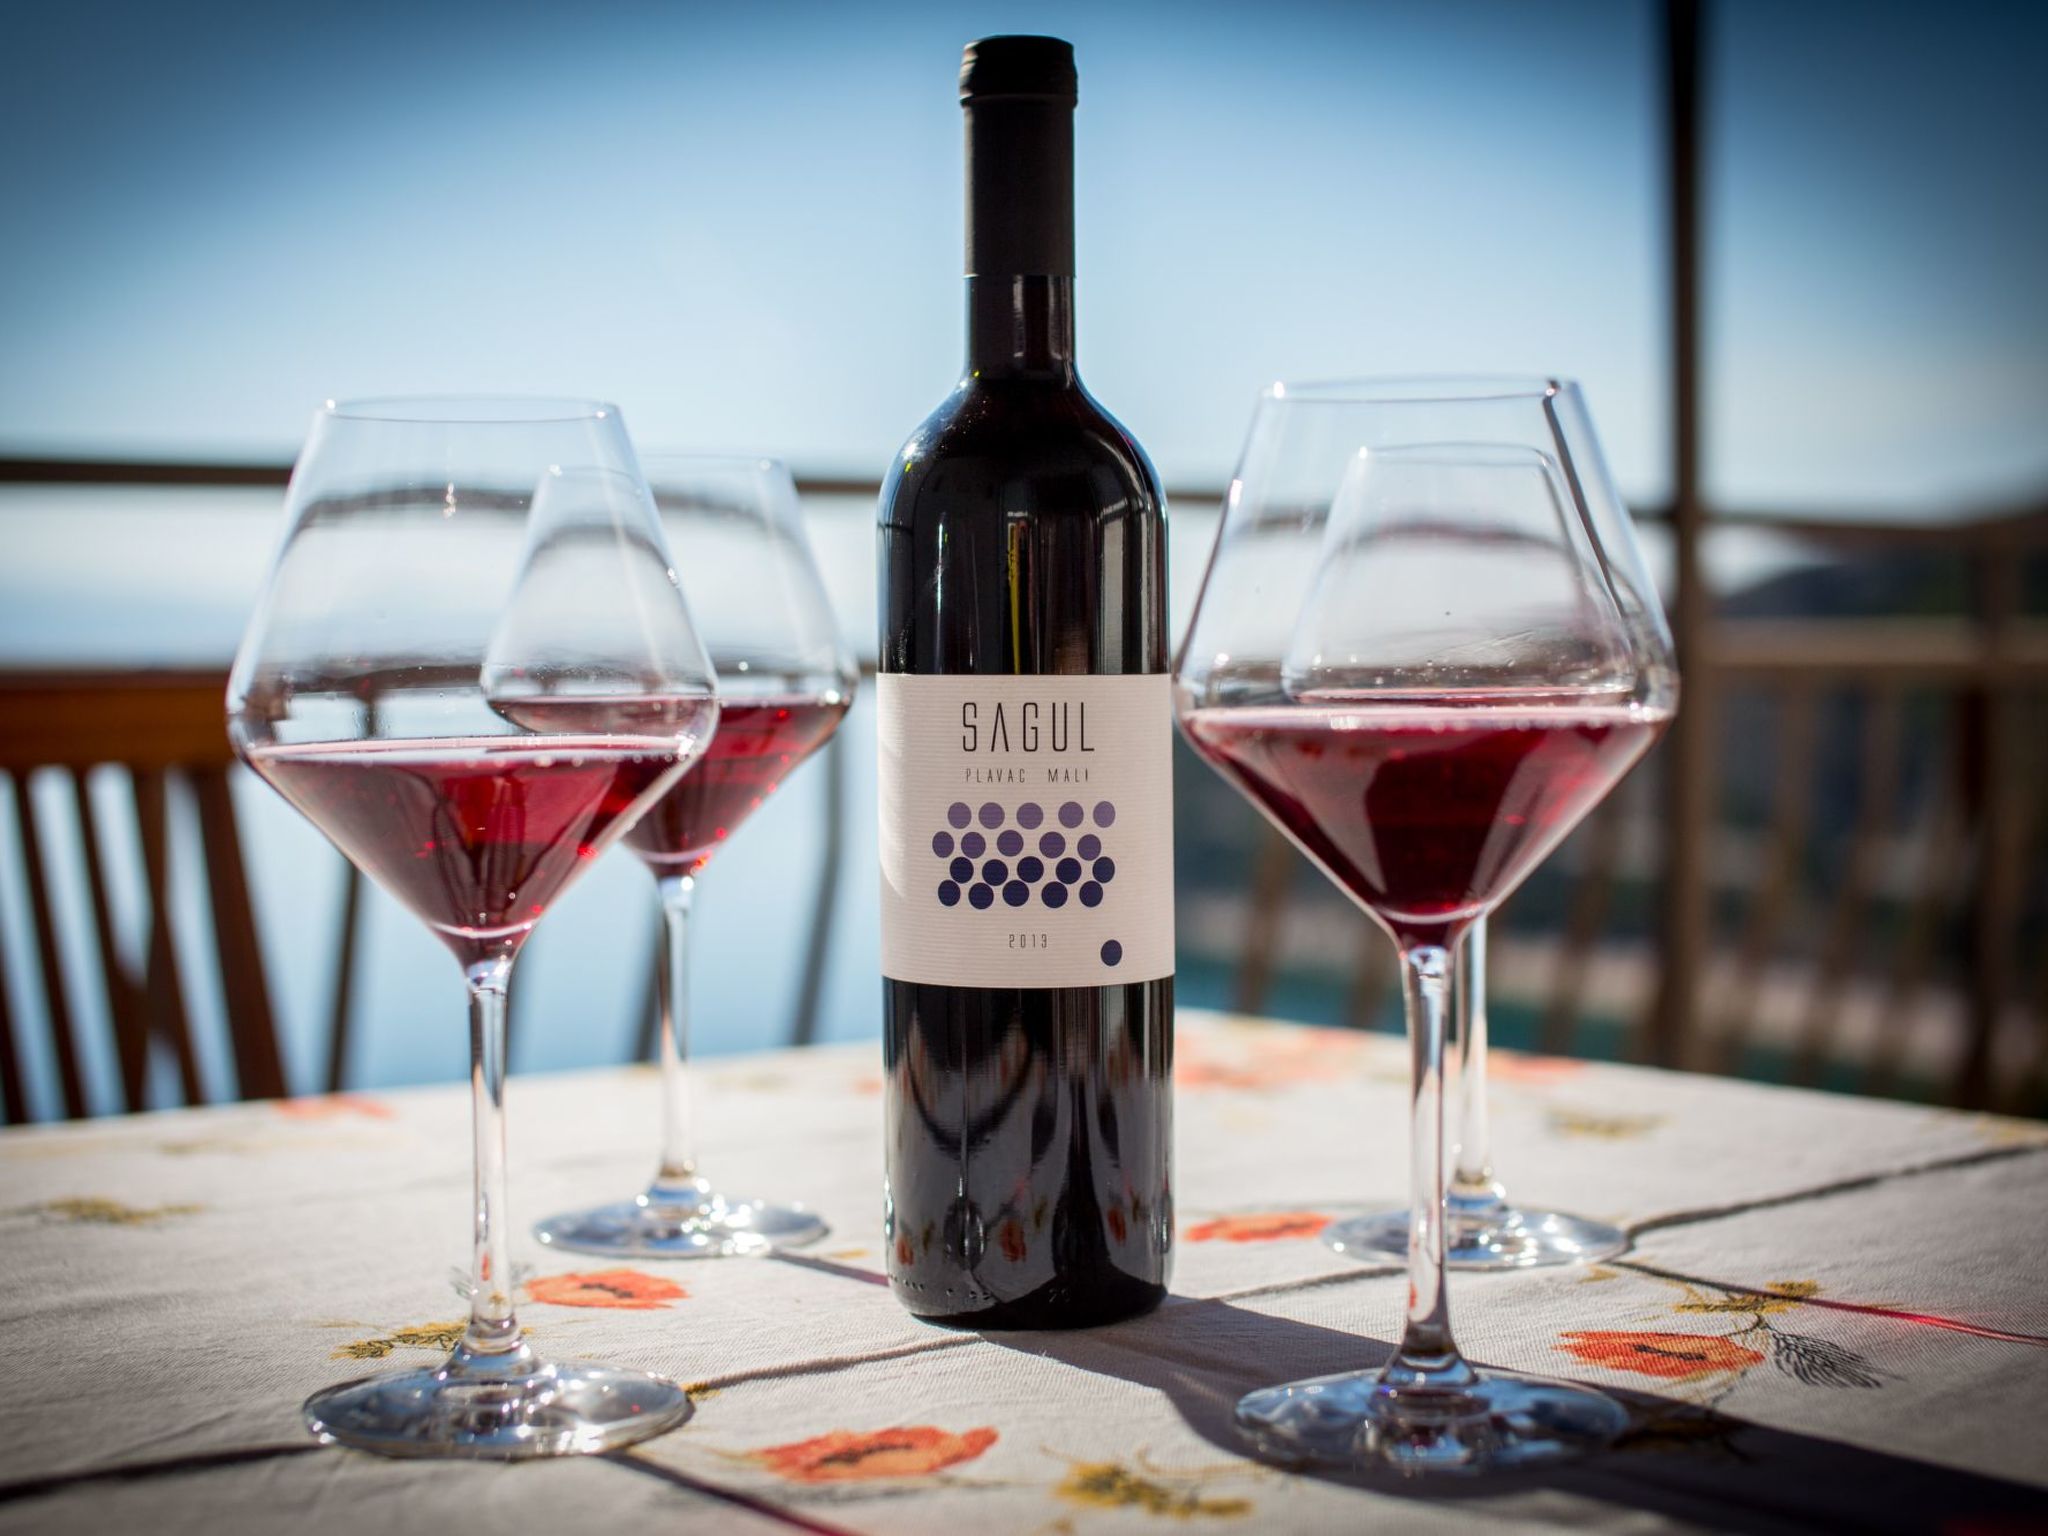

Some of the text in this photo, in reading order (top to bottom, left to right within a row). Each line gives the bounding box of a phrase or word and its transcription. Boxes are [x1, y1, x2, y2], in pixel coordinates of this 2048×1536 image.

[962, 701, 1095, 752] SAGUL
[1047, 768, 1089, 783] MALI
[1008, 933, 1048, 949] 2013
